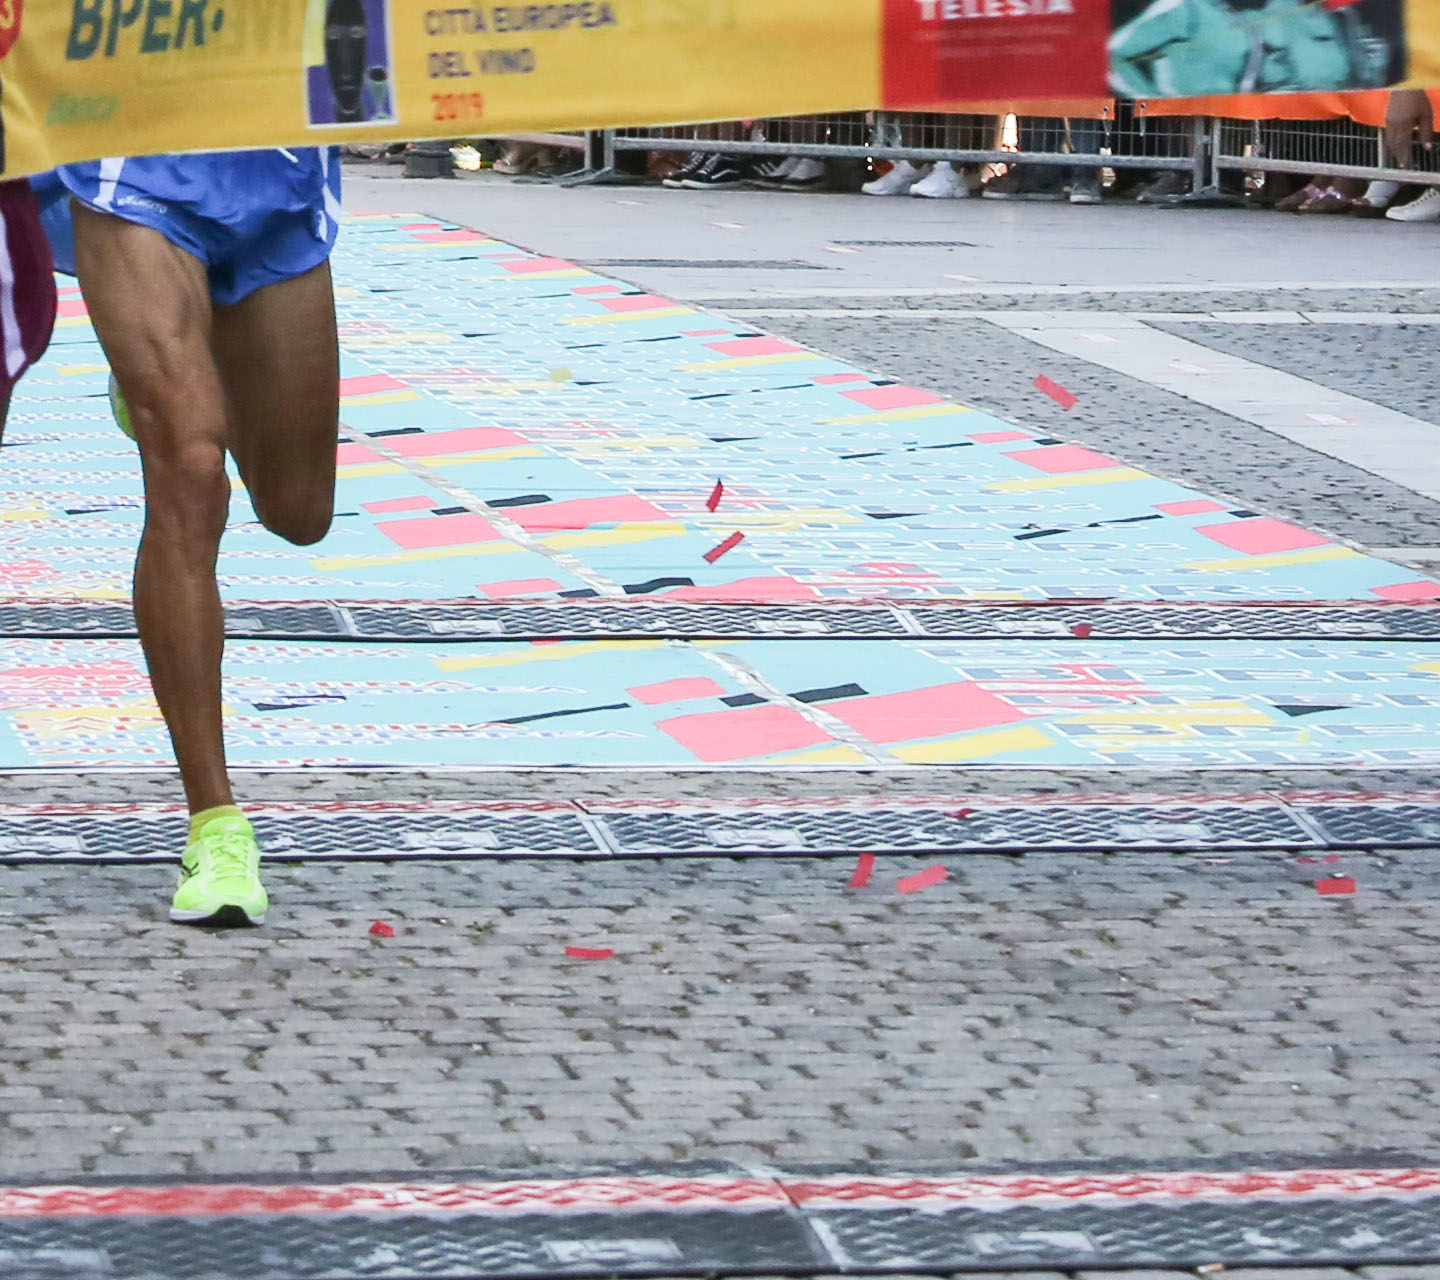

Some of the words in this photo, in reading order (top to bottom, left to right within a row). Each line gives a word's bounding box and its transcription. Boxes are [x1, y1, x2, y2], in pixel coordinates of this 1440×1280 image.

[493, 0, 620, 34] EUROPEA
[426, 50, 474, 81] DEL
[429, 91, 485, 123] 2019
